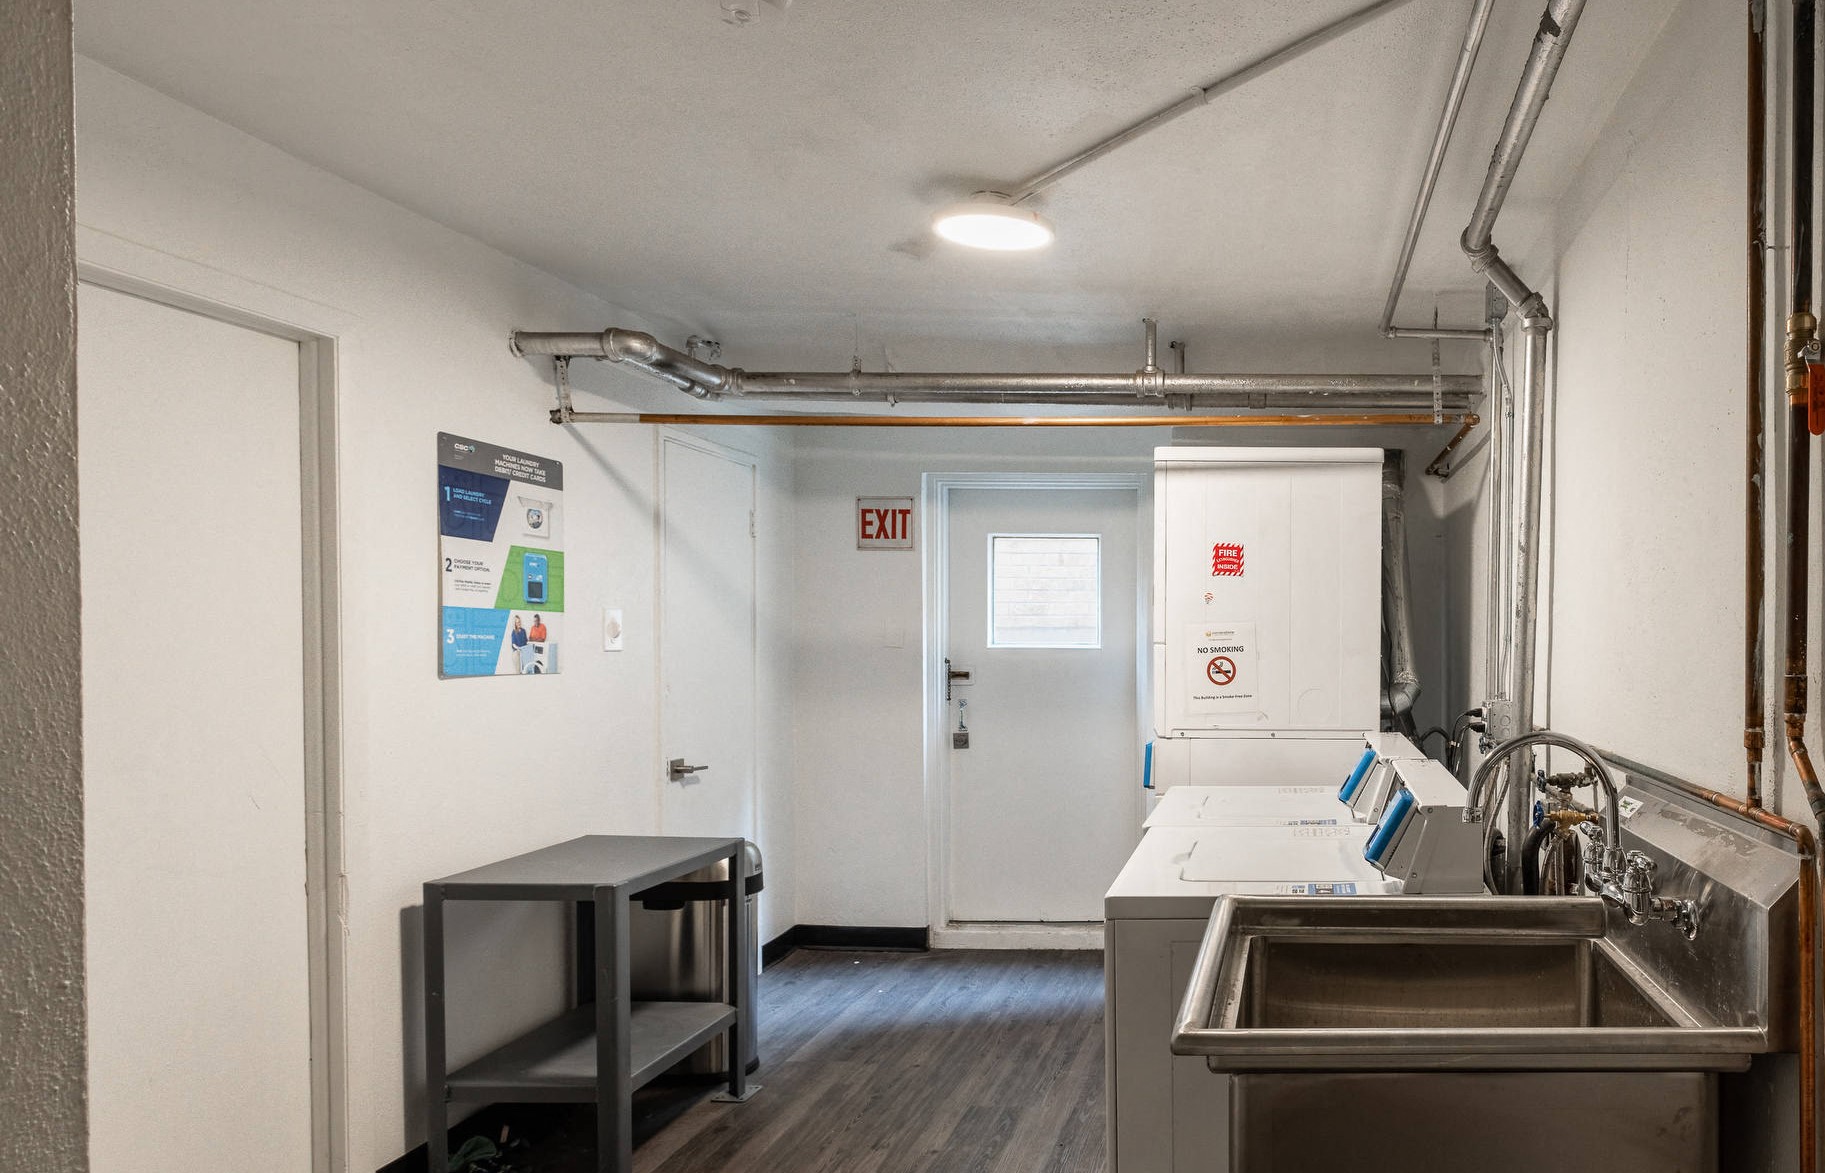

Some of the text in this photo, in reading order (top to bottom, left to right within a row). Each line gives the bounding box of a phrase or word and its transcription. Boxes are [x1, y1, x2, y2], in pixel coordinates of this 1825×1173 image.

[494, 460, 546, 476] MACHINES NOW TAKE
[502, 454, 539, 468] YOUR LAUNDRY
[512, 469, 530, 479] CREDIT
[530, 473, 546, 482] CARDS
[444, 486, 451, 502] 1
[861, 508, 911, 540] EXIT
[1218, 549, 1238, 557] FIRE
[445, 557, 452, 572] 2
[446, 628, 455, 644] 3
[1197, 645, 1244, 654] NO SMOKING
